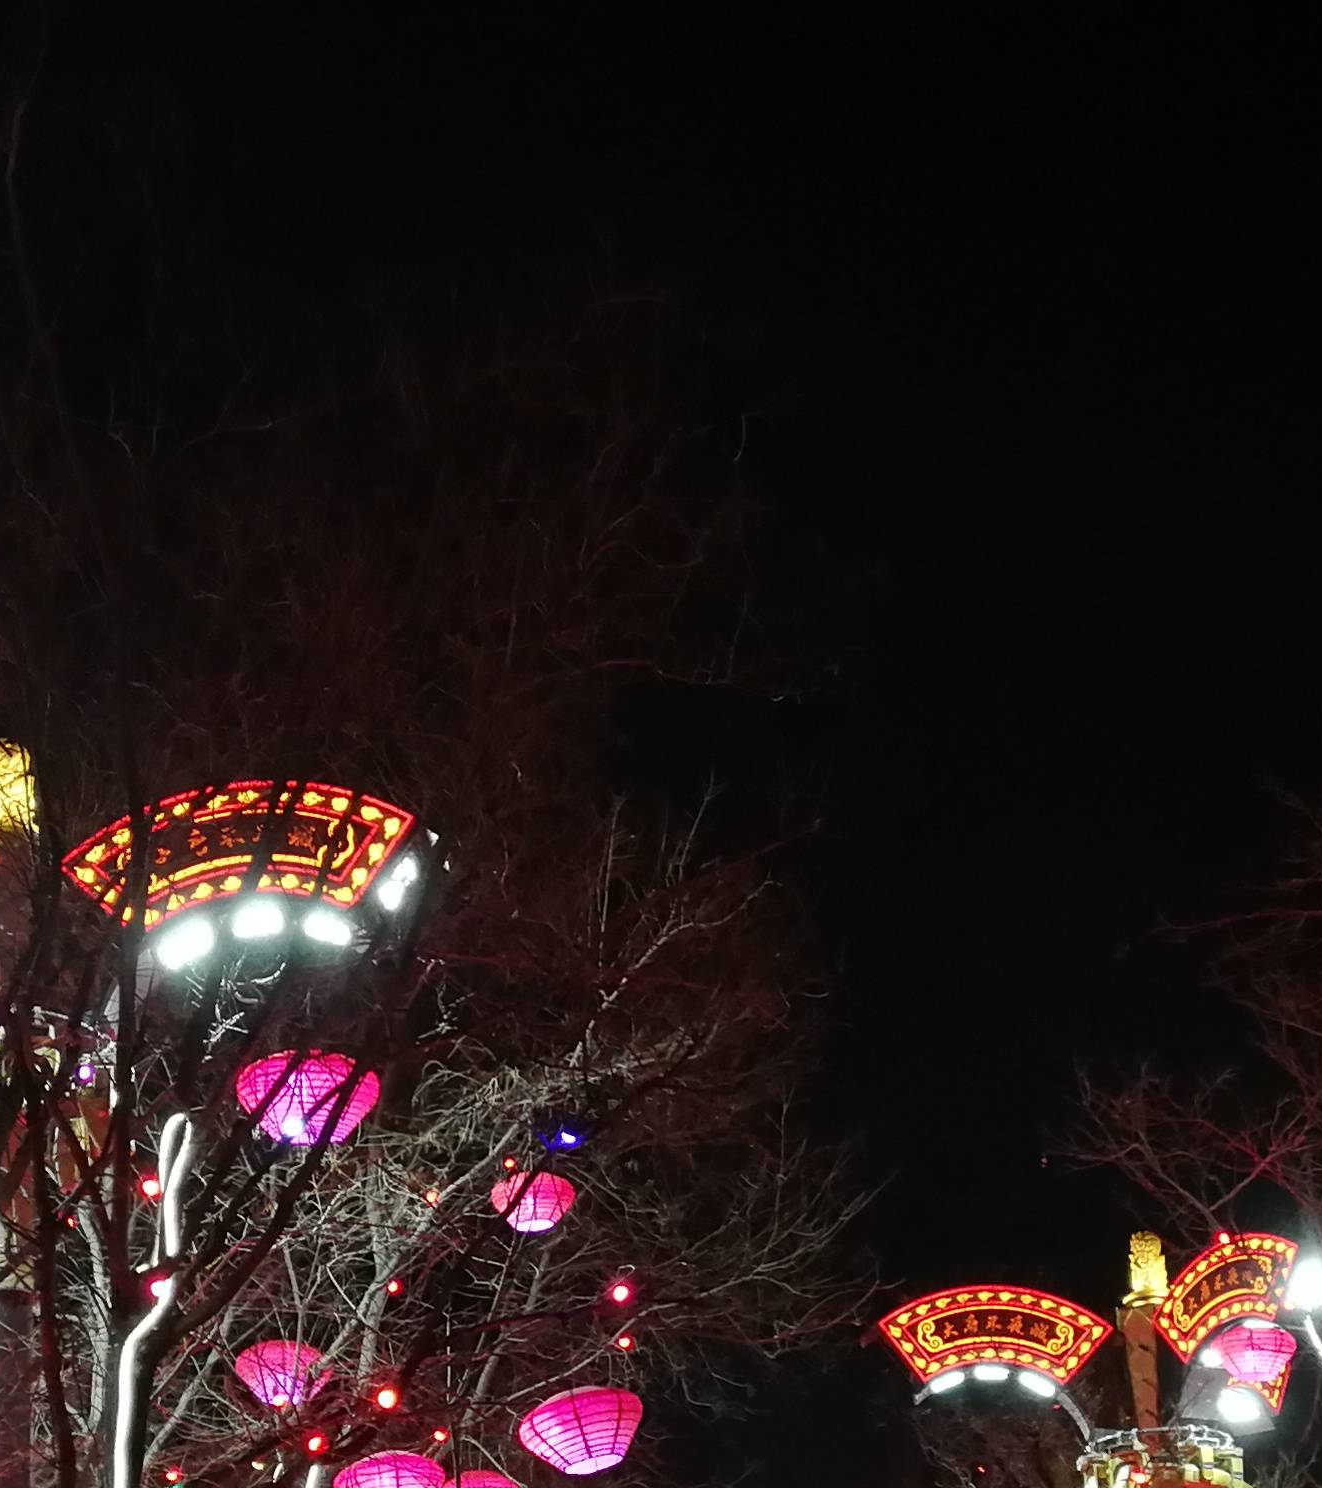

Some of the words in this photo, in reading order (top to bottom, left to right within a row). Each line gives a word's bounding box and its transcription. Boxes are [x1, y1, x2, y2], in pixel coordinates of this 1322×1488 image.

[941, 1313, 1050, 1344] 大唐不夜城
